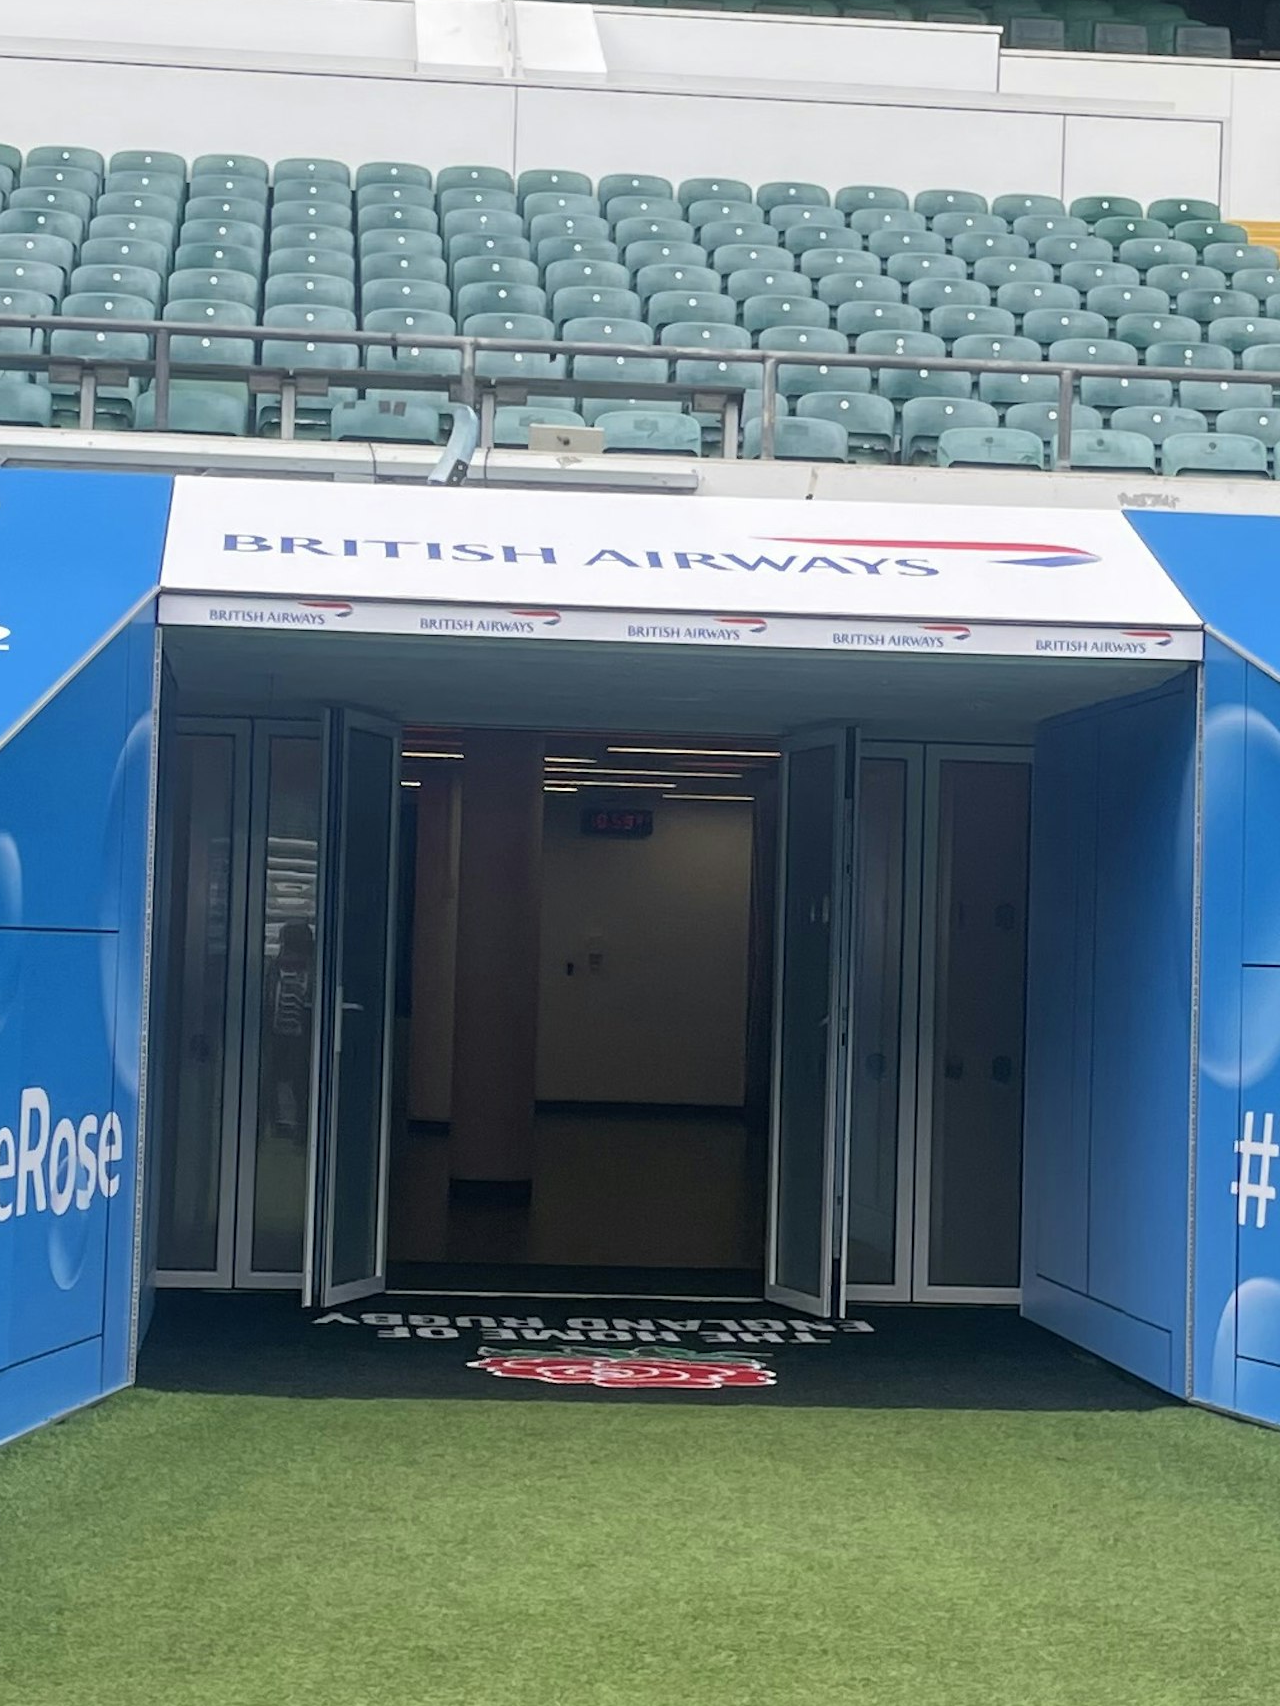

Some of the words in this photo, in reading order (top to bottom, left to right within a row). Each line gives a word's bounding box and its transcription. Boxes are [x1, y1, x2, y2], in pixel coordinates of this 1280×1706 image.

[222, 533, 557, 565] BRITISH
[583, 548, 940, 577] AIRWAYS
[208, 608, 264, 624] BRITISH
[265, 612, 325, 626] AIRWAYS
[419, 618, 475, 633] BRITISH
[476, 620, 535, 634] AIRWAYS
[627, 625, 682, 640] BRITISH
[683, 628, 741, 642] AIRWAYS
[832, 633, 884, 647] BRITISH
[885, 635, 944, 649] AIRWAYS
[1035, 639, 1089, 653] BRITISH
[1090, 641, 1147, 655] AIRWAYS
[312, 1311, 544, 1329] RUGBY
[567, 1317, 876, 1334] ENGLAND
[376, 1326, 459, 1340] OF
[483, 1327, 681, 1343] HOME
[704, 1330, 831, 1344] THE
